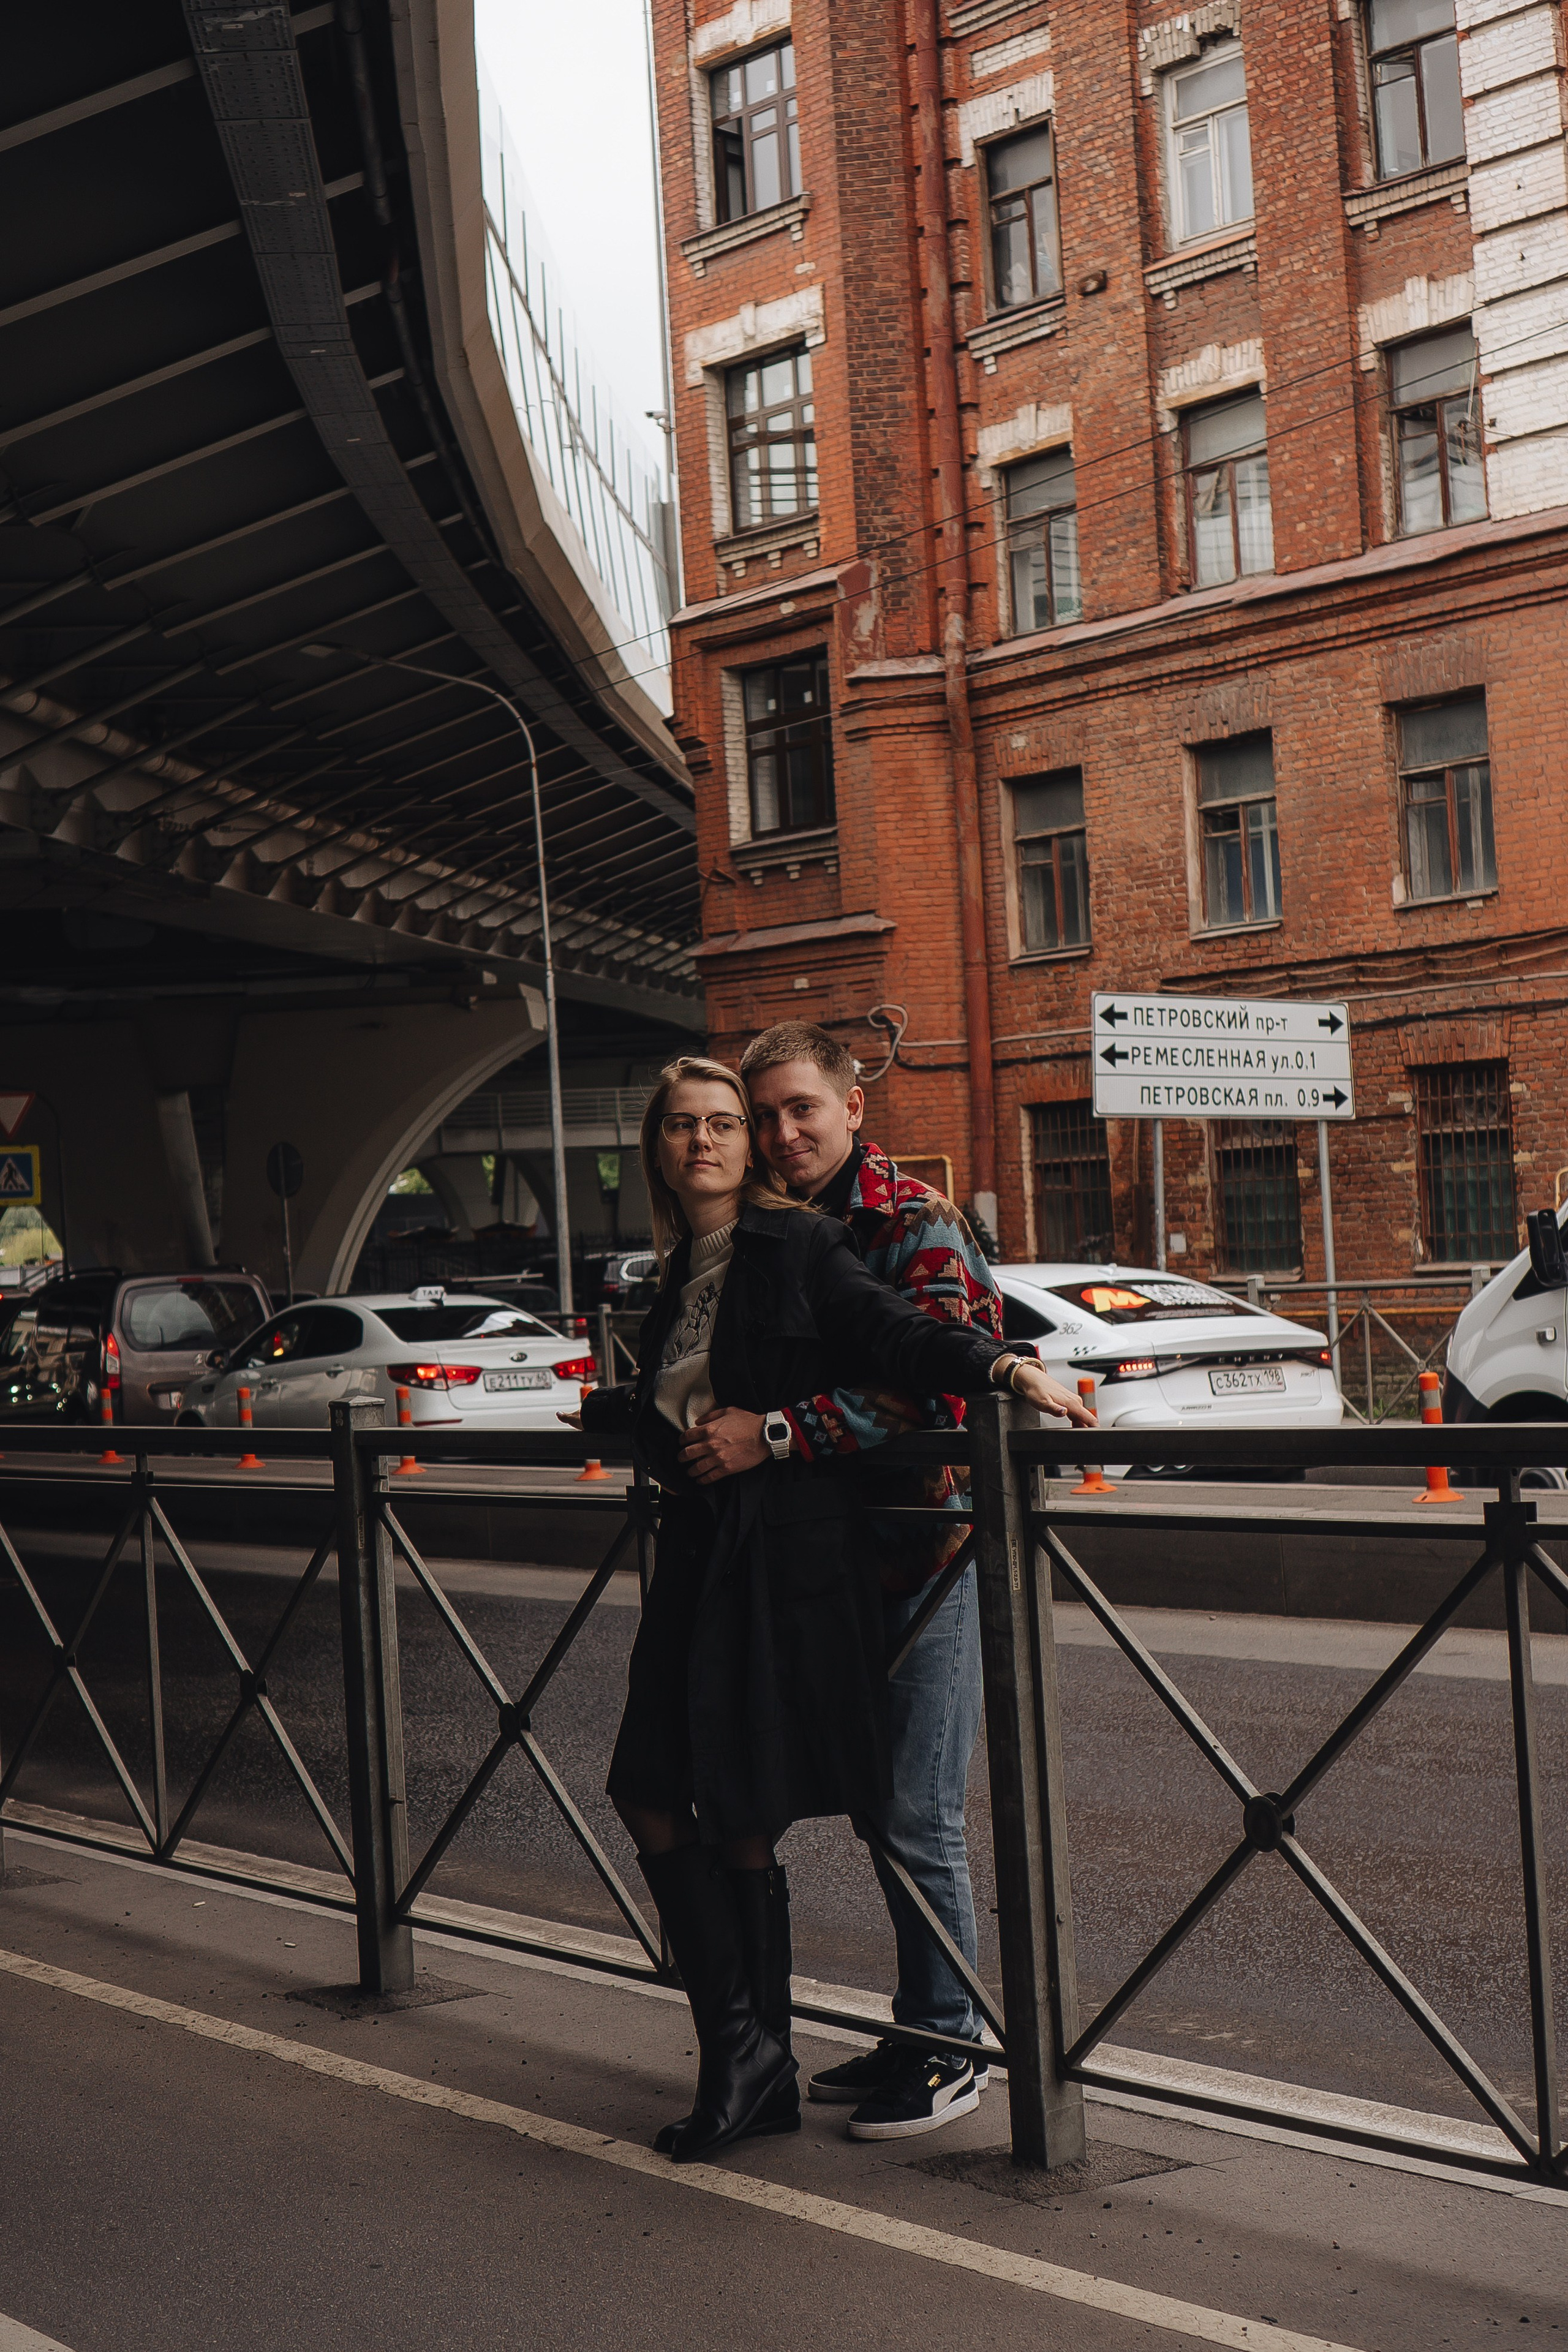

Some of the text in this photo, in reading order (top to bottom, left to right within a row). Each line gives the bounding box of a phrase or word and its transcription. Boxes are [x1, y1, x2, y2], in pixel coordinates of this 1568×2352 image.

[1134, 1005, 1287, 1035] ПЕТРОВСКИЙ пр-т
[1131, 1046, 1266, 1068] РЕМЕСЛЕННАЯ
[1140, 1086, 1259, 1106] ПЕТРОВСКАЯ
[1265, 1093, 1287, 1107] пл.
[1059, 1322, 1083, 1335] 362
